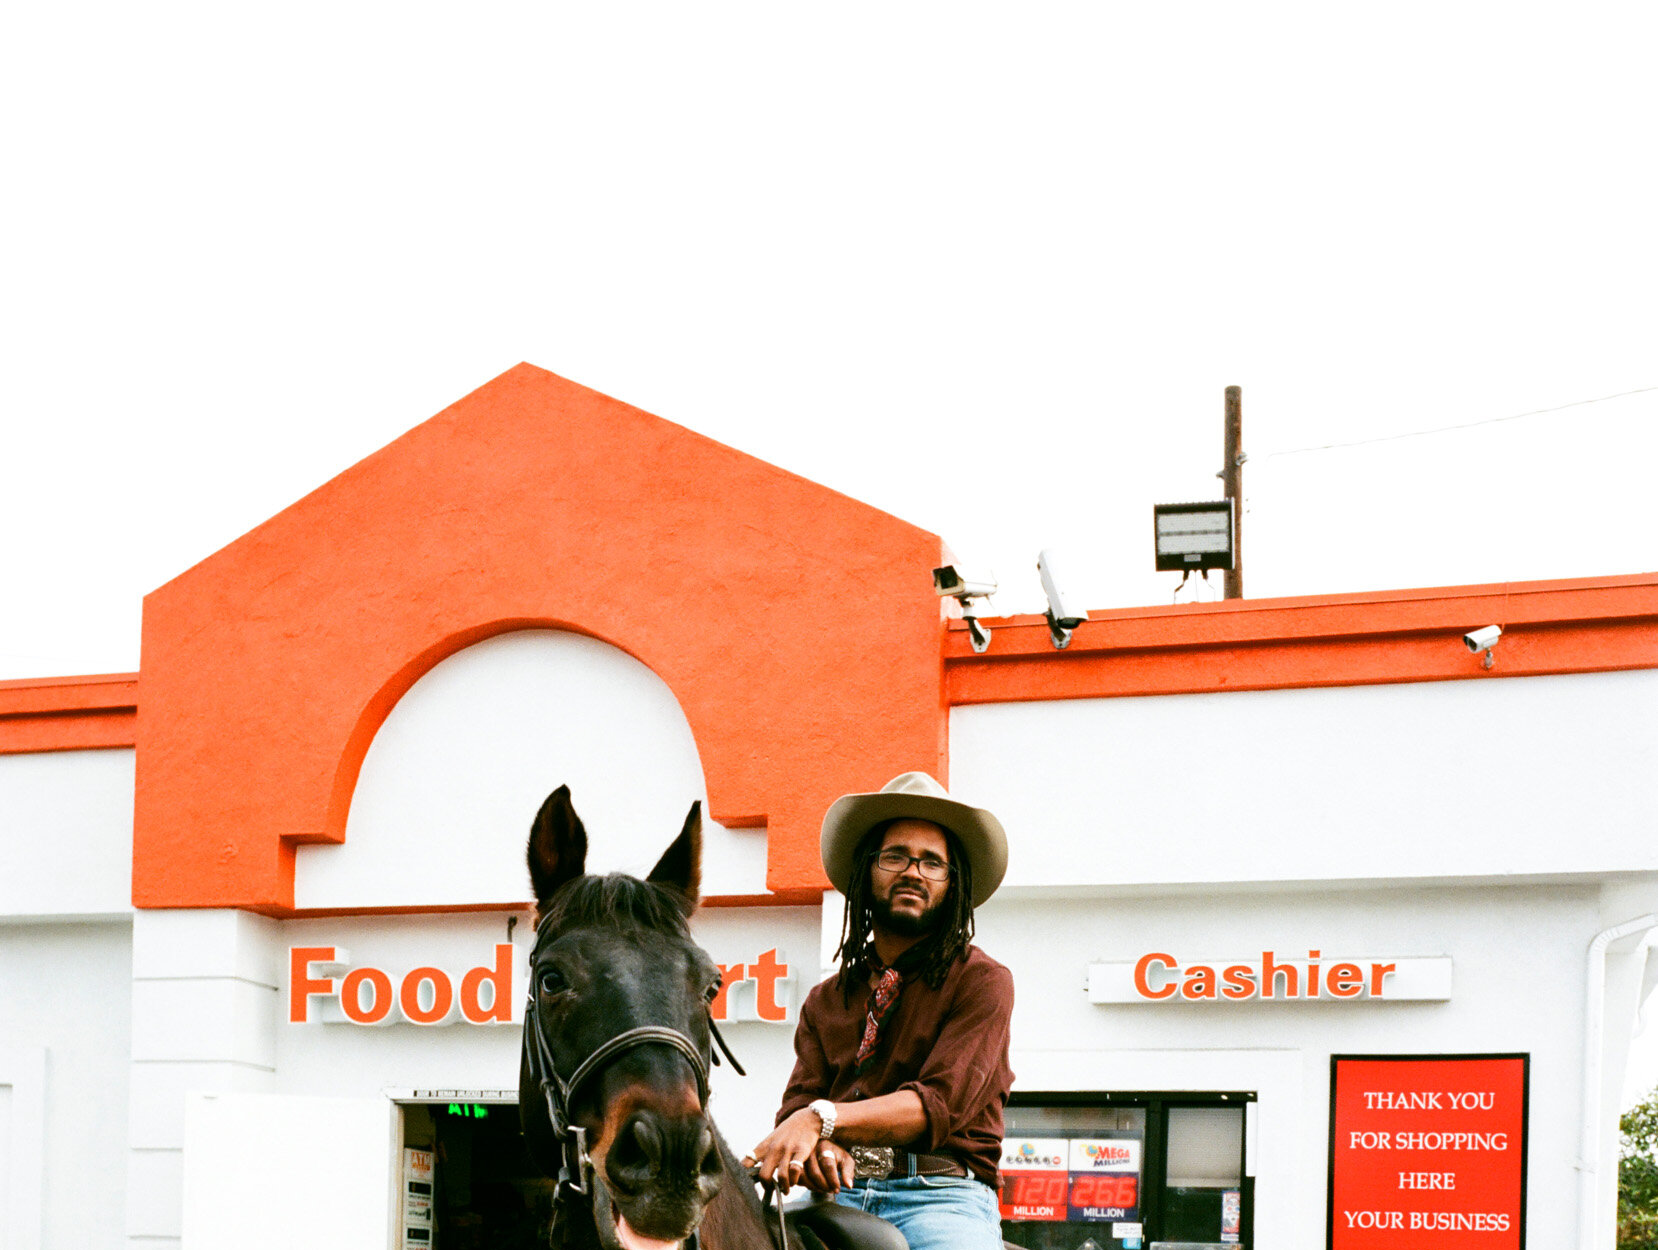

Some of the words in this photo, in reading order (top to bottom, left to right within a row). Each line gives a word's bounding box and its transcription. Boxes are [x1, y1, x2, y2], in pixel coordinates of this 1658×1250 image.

[289, 944, 514, 1024] Food
[709, 948, 788, 1022] rt
[1134, 949, 1396, 1000] Cashier
[1364, 1092, 1443, 1110] THANK
[1447, 1092, 1495, 1110] YOU
[1349, 1131, 1392, 1150] FOR
[1395, 1132, 1508, 1151] SHOPPING
[1095, 1145, 1130, 1160] MEGA
[1016, 1176, 1066, 1205] 120
[1398, 1172, 1456, 1190] HERE
[1013, 1205, 1054, 1217] MILLION
[1083, 1207, 1125, 1218] MILLION
[1344, 1210, 1405, 1229] YOUR
[1409, 1211, 1510, 1232] BUSINESS
